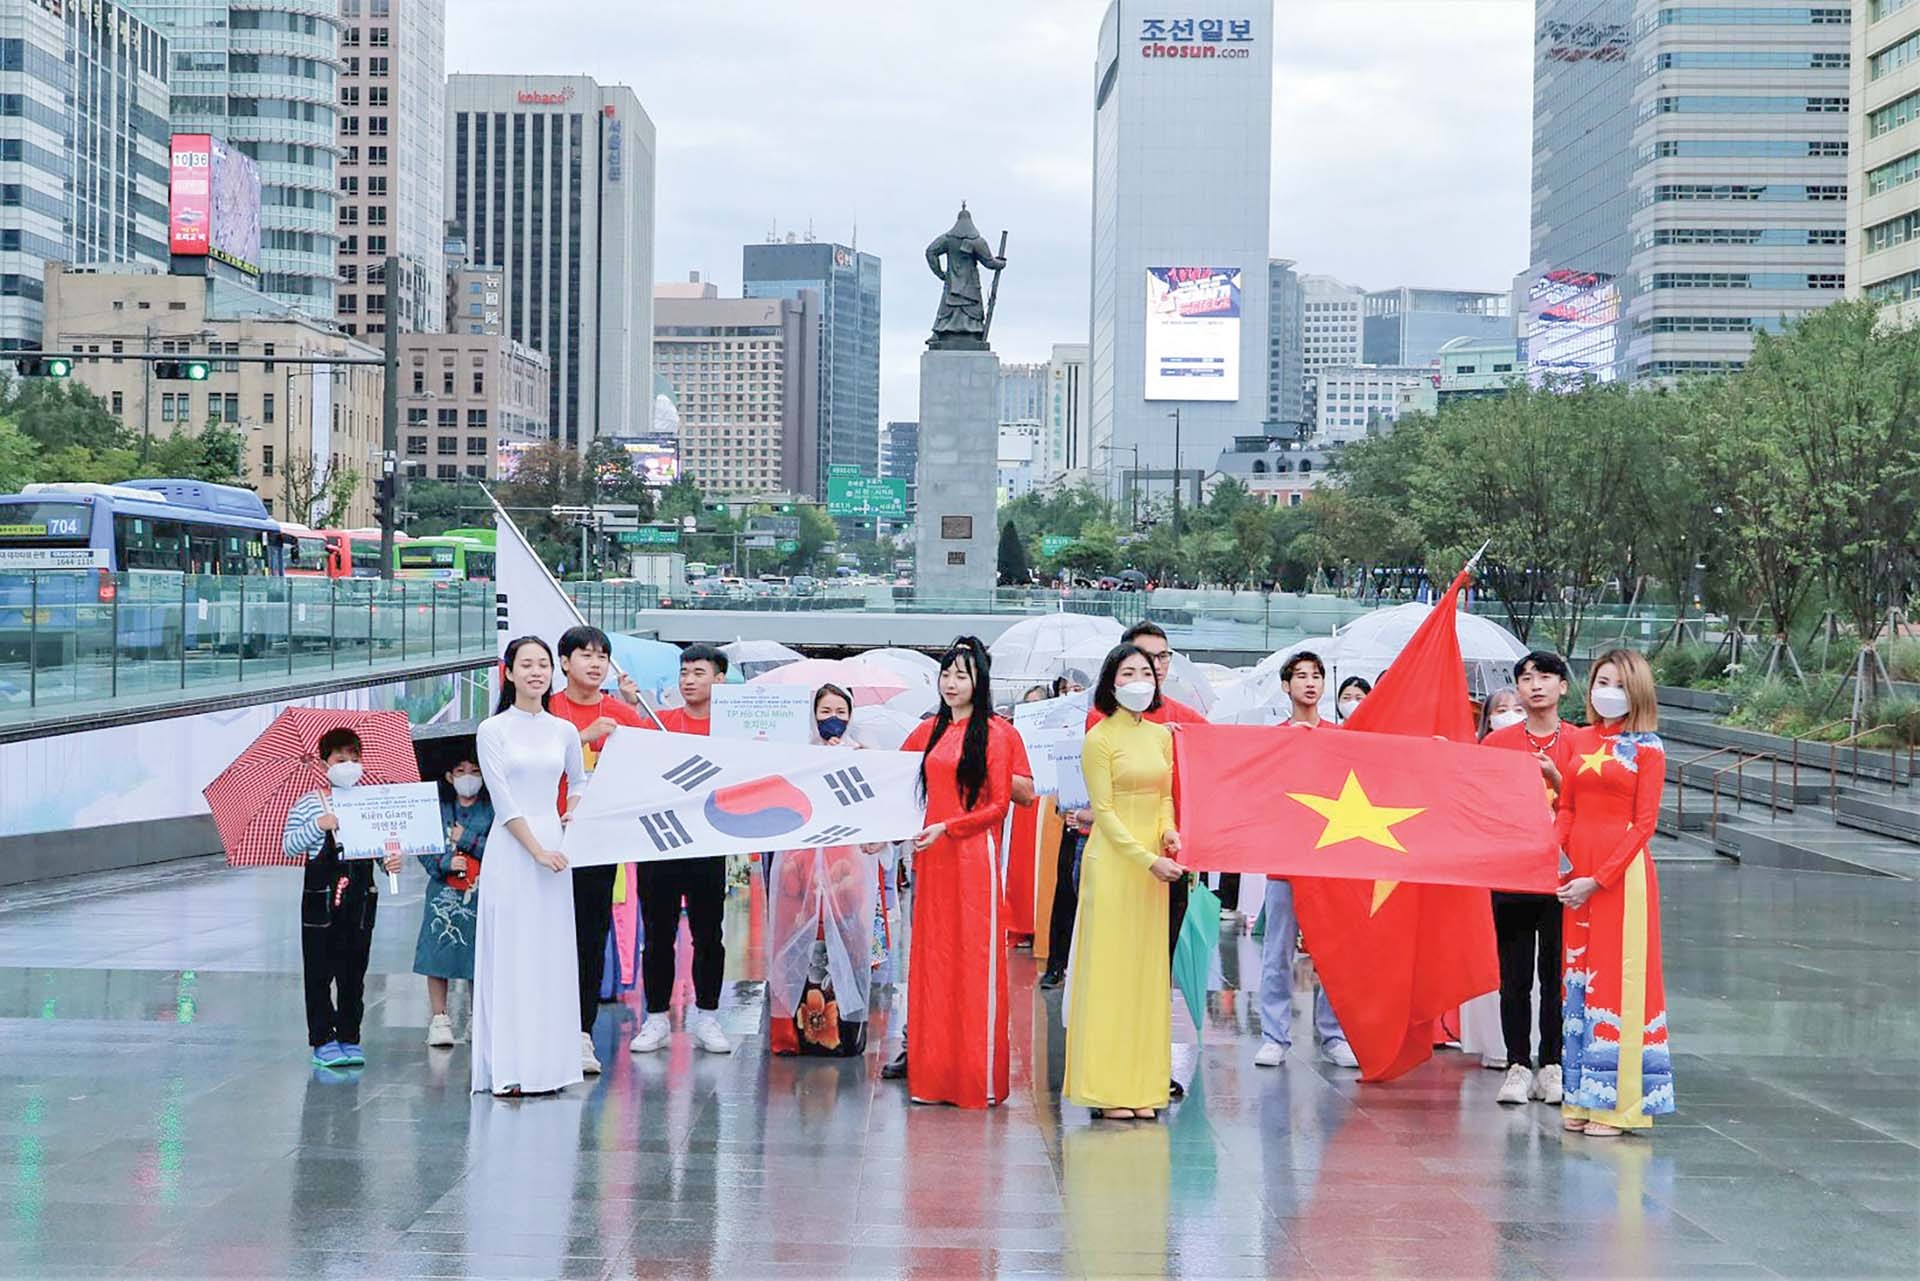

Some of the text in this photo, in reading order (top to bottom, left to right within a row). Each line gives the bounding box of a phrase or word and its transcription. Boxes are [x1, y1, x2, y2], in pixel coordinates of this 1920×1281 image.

[1140, 18, 1254, 42] 조선일보
[1142, 43, 1249, 59] chosun.com
[517, 90, 566, 105] kobaco
[50, 518, 77, 534] 704
[385, 810, 414, 820] Giang
